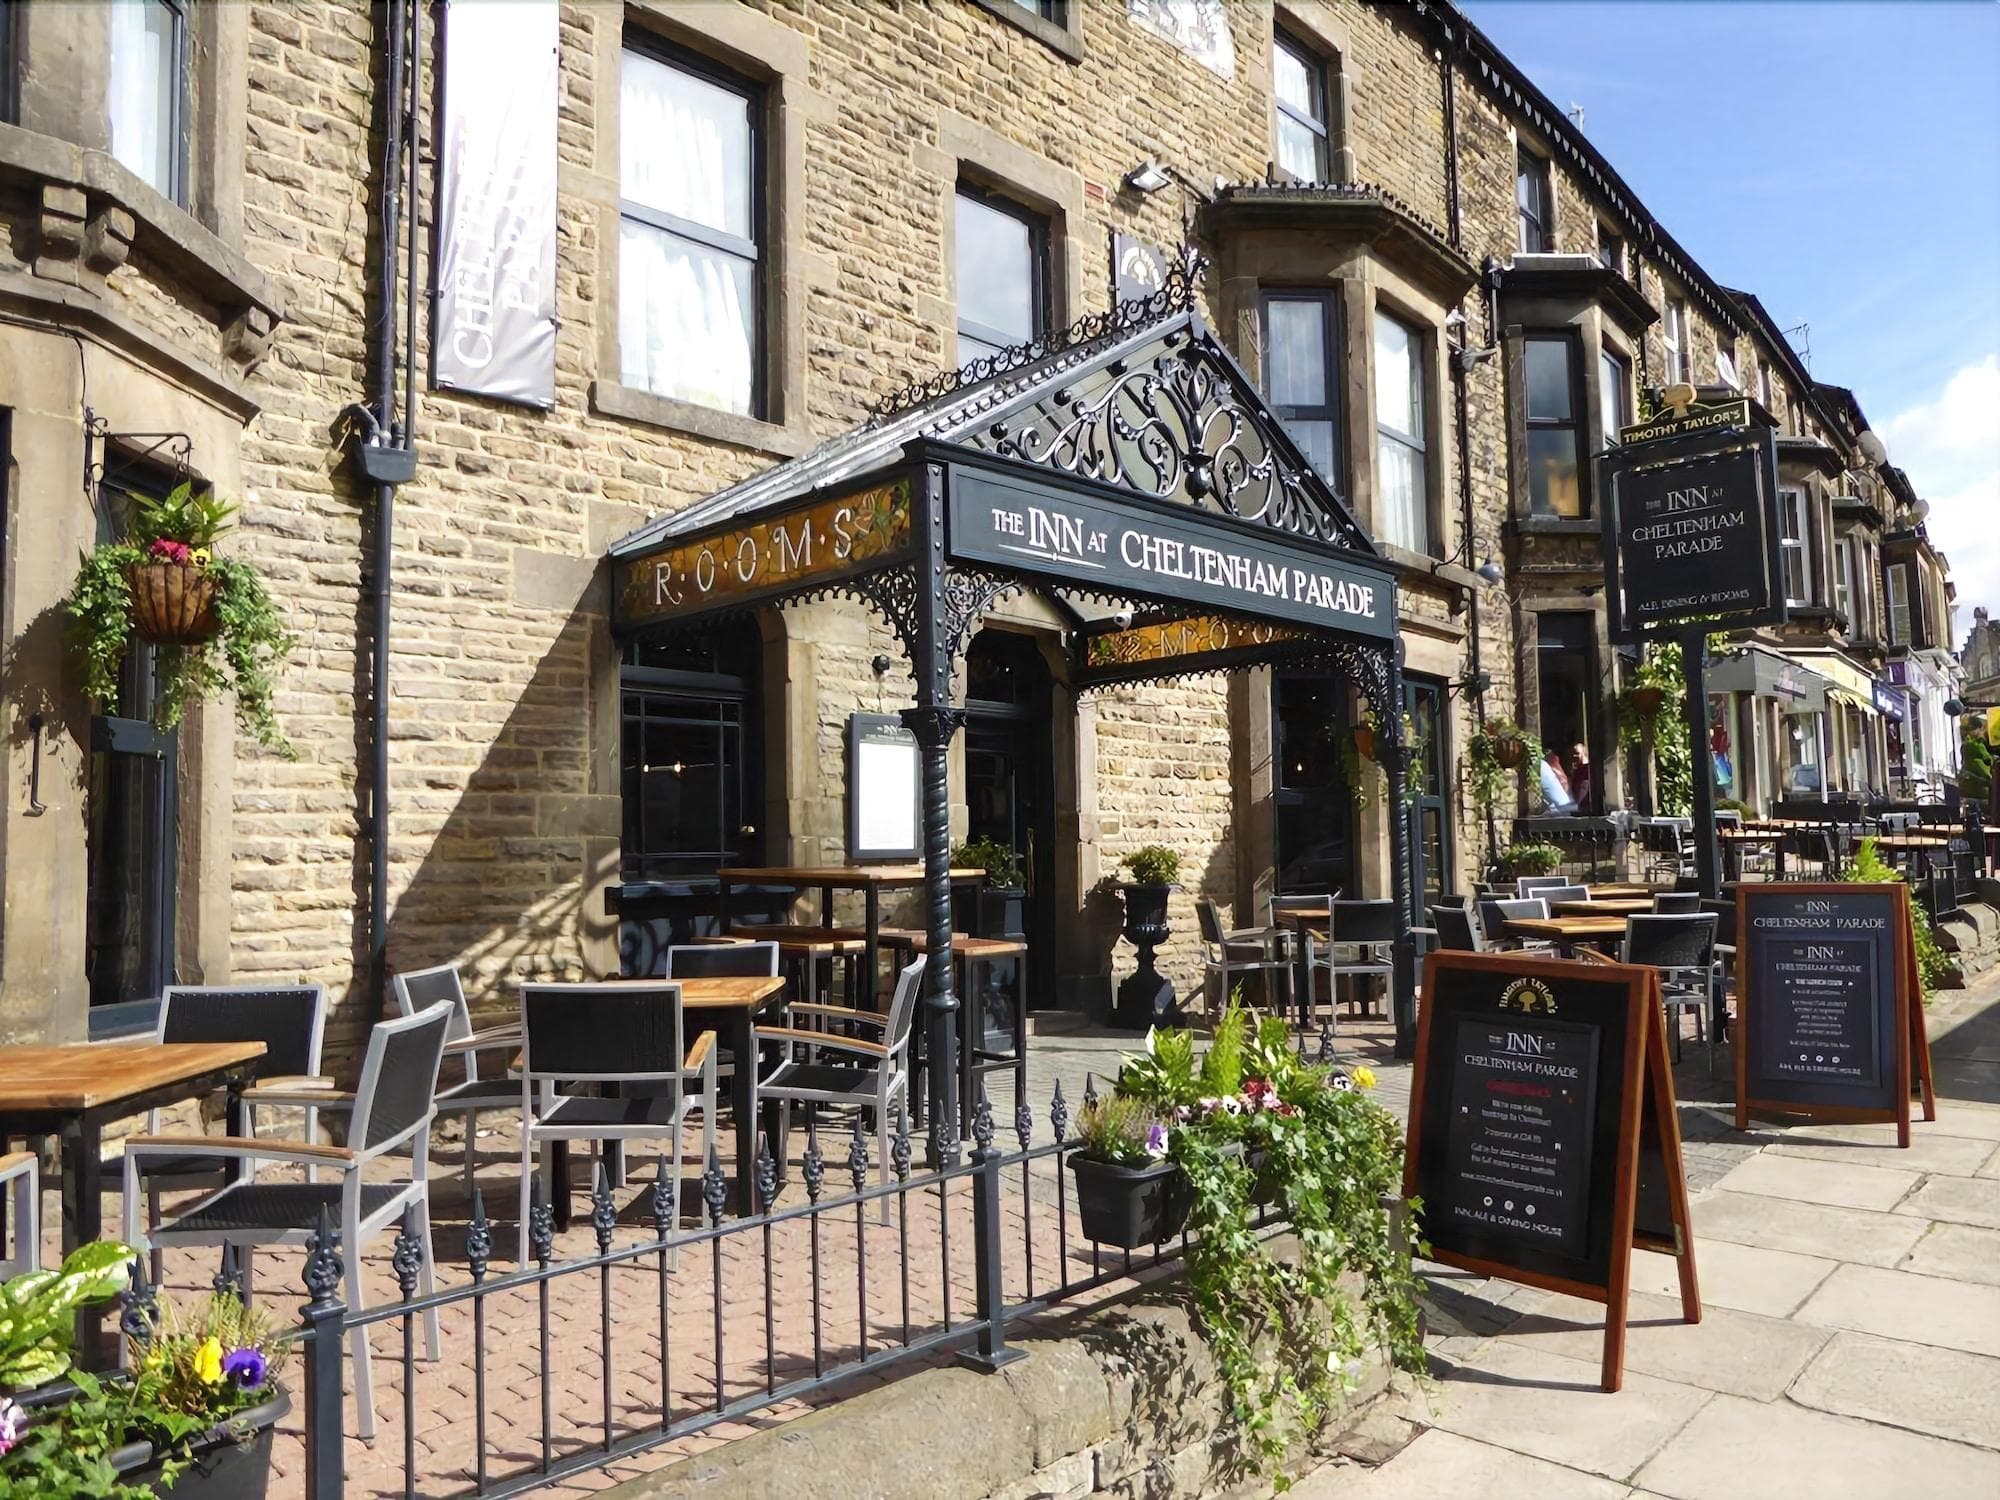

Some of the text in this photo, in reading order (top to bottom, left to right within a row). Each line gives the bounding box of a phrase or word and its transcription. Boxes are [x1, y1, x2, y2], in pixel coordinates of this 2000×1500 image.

[1622, 409, 1741, 444] TIMOTHY TAYLOR'S
[1666, 485, 1709, 511] INN
[1631, 510, 1745, 542] CHELTENHAM
[1655, 535, 1724, 559] PARADE
[991, 506, 1376, 618] THE INN AT CHELTENHAM PARADE
[1806, 900, 1831, 912] INN
[1836, 917, 1886, 929] PARADE
[1807, 946, 1834, 960] INN
[1505, 1031, 1544, 1055] INN
[1464, 1053, 1579, 1079] CHELTENHAM PARADE
